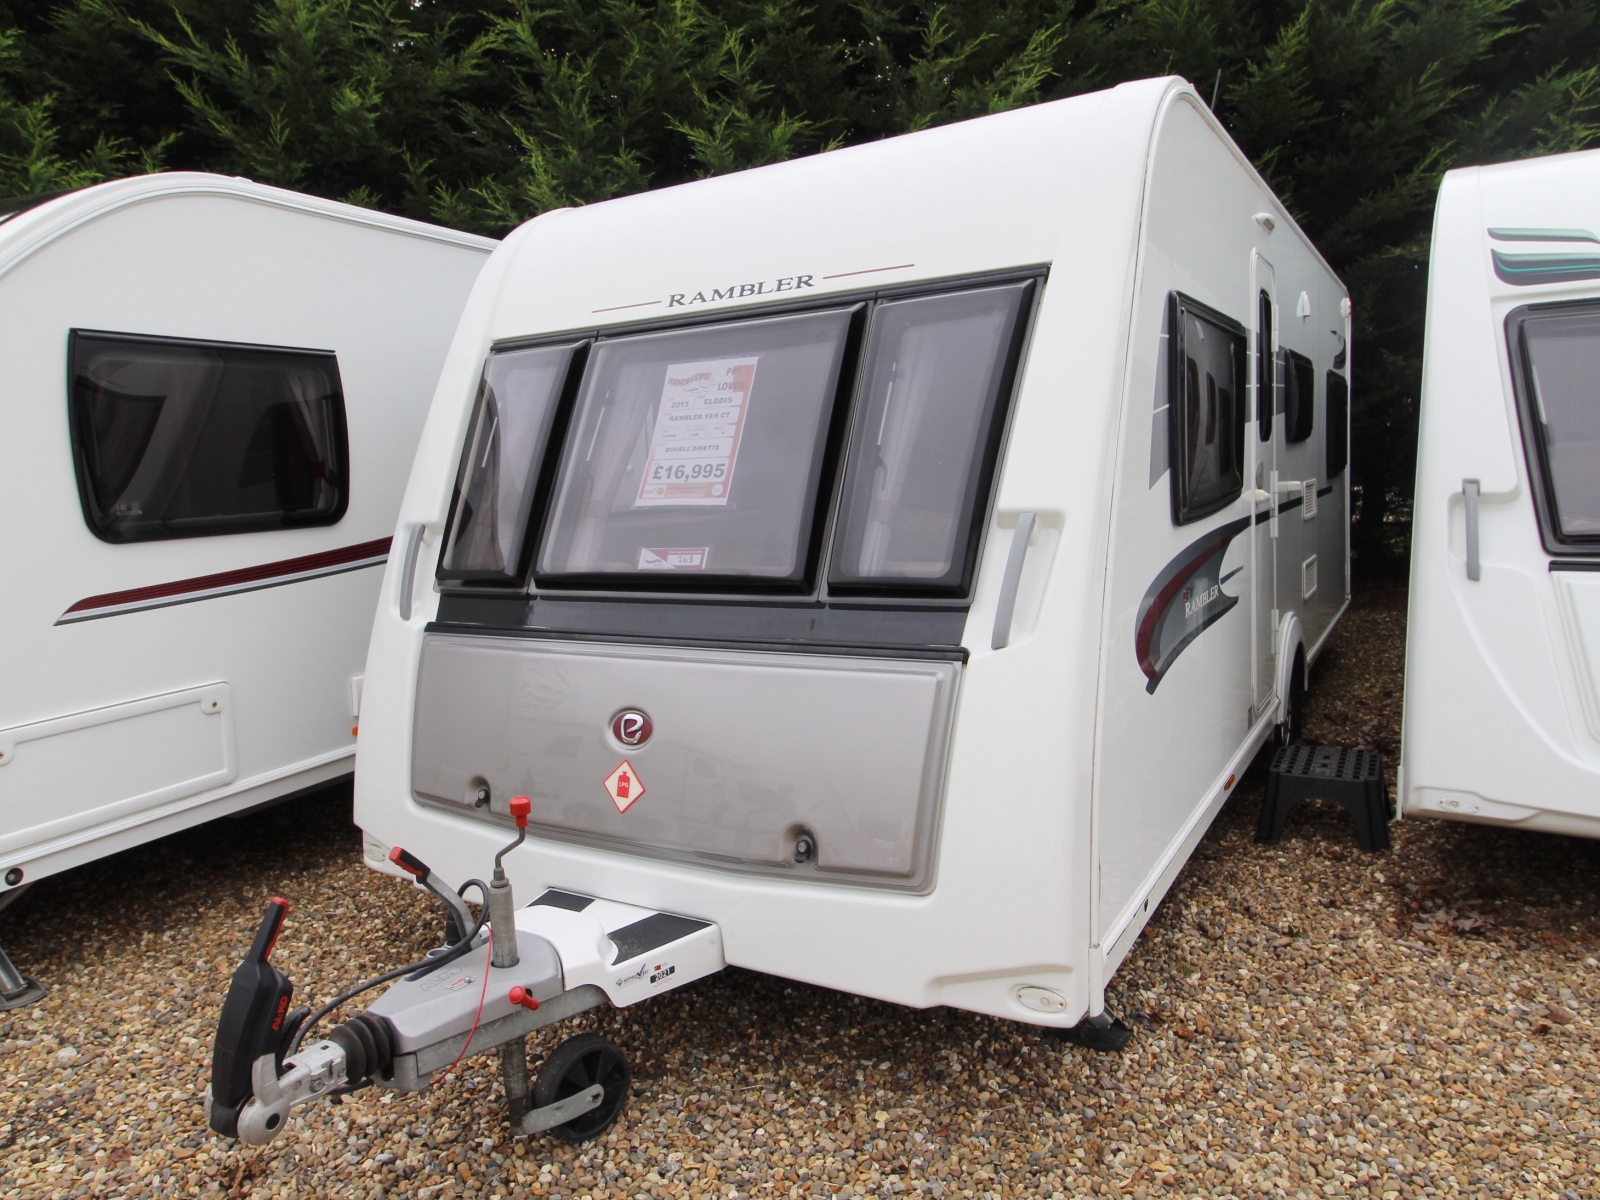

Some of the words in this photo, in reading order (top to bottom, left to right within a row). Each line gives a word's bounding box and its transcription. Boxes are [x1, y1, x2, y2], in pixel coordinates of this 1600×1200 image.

[667, 275, 815, 308] RAMBLER
[726, 367, 743, 376] PRE
[717, 381, 745, 391] LOVED
[671, 401, 690, 409] 2015
[704, 396, 733, 405] ELDDIS
[669, 414, 703, 422] RAMBLER
[721, 411, 731, 419] CT
[692, 444, 721, 452] DINETTE
[652, 463, 725, 482] £16,995
[677, 555, 694, 564] 263
[1185, 584, 1219, 618] RAMBLER
[655, 969, 670, 981] 2021
